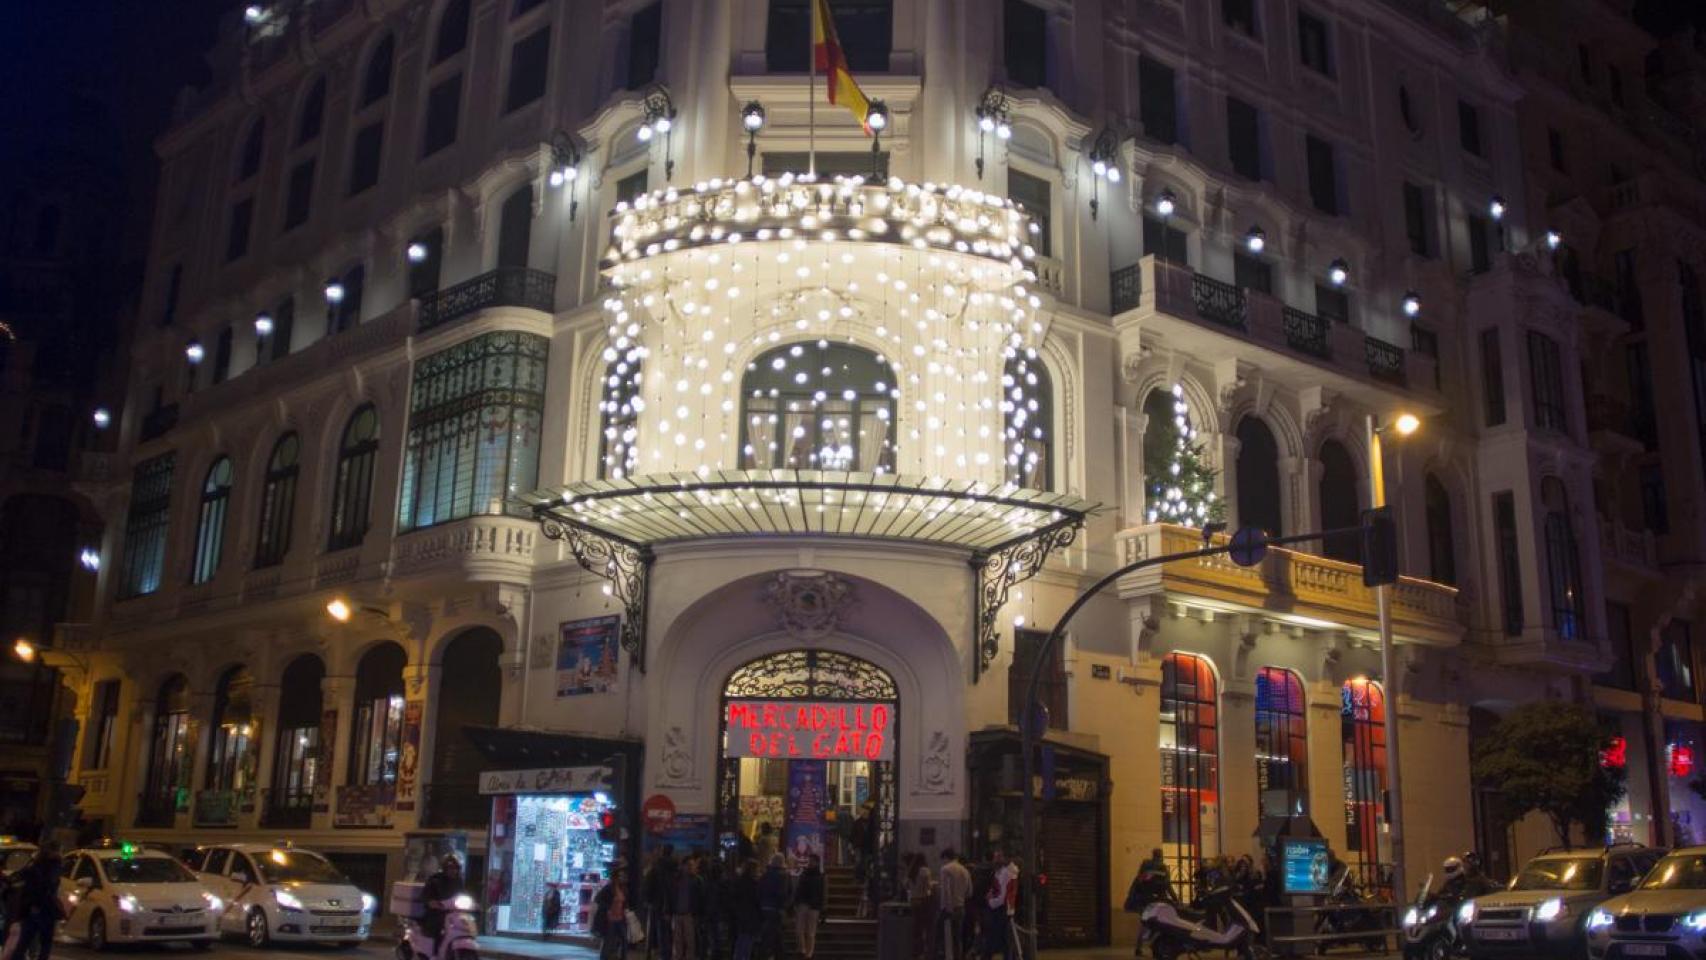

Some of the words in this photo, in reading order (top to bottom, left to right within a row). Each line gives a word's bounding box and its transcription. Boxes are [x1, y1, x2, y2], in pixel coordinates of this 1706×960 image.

[729, 703, 888, 731] MERCADILLO
[750, 732, 801, 757] DEL
[812, 731, 884, 760] GATO
